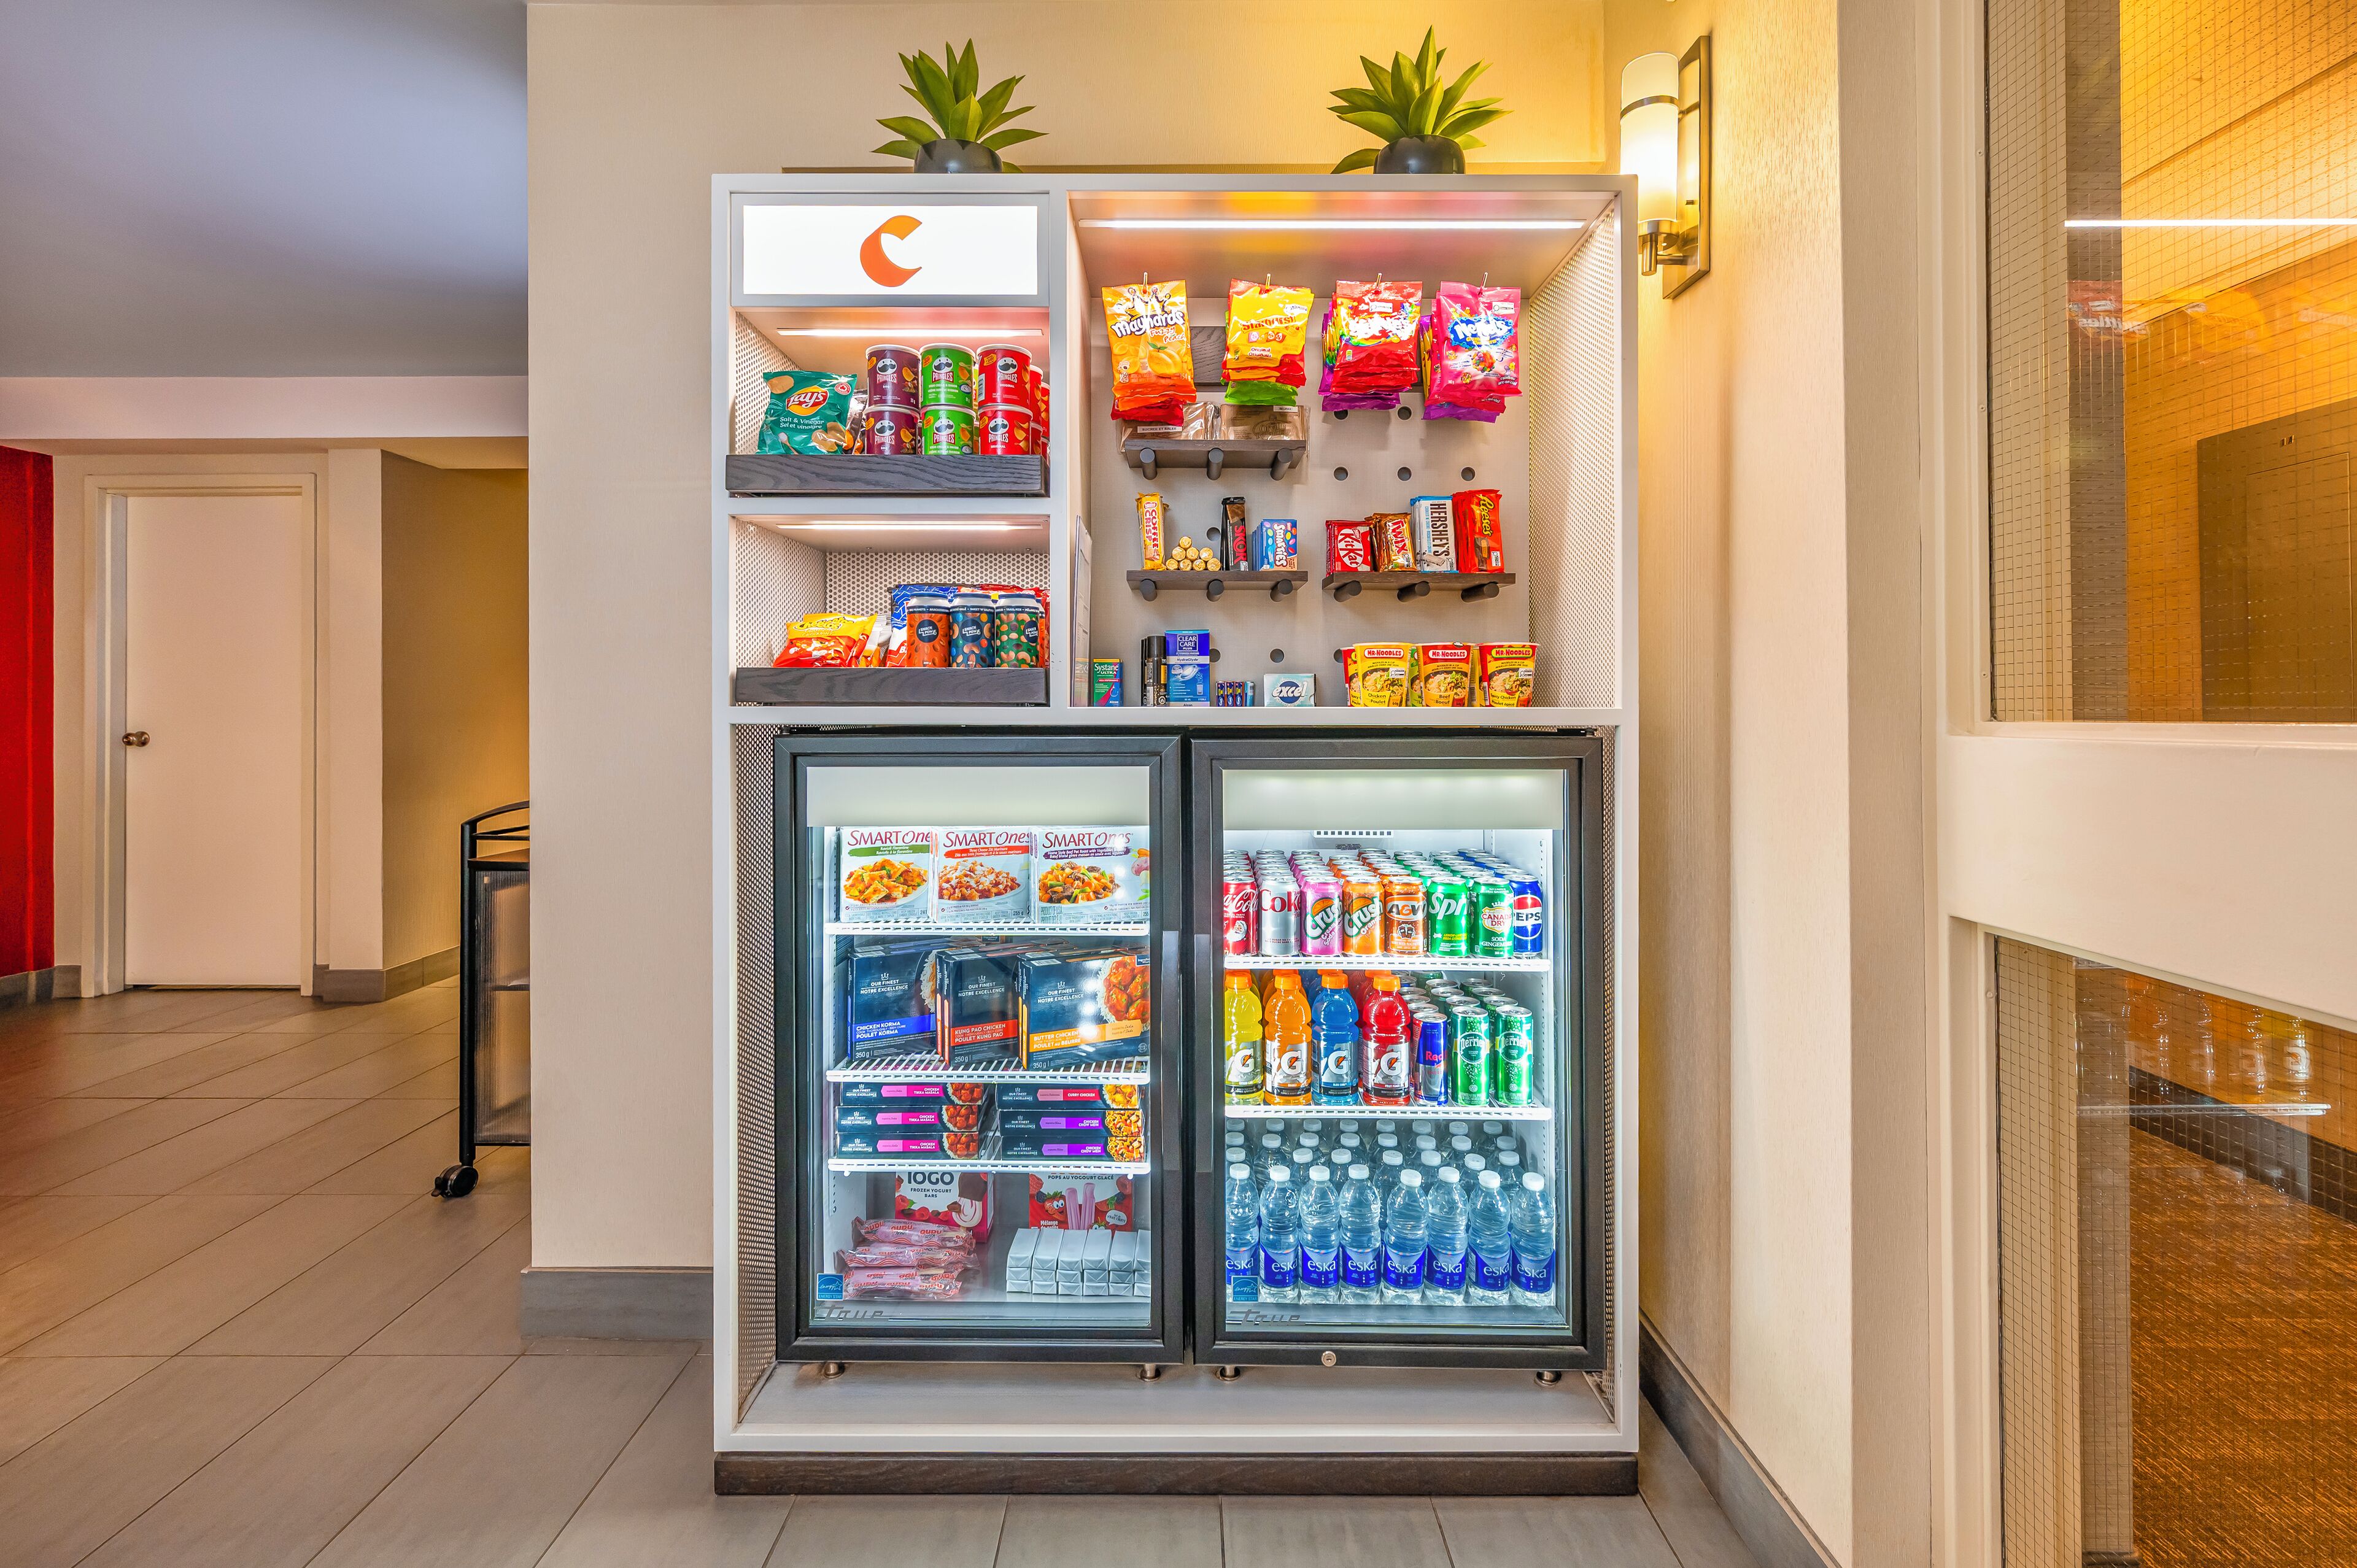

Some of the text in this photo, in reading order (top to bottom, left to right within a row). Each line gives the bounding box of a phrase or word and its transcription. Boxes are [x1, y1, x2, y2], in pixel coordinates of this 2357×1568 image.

[1150, 327, 1175, 337] Fuzzy
[877, 374, 897, 383] PRINGLES
[932, 372, 953, 382] PRINGLES
[997, 373, 1018, 383] PRINGLES
[788, 391, 826, 408] Lay's
[875, 435, 894, 444] PRINGLES
[934, 434, 954, 443] PRINGLES
[989, 434, 1008, 442] PRINGLES
[1430, 503, 1450, 557] HERSHEY'S
[1234, 525, 1247, 563] SKOR
[1094, 663, 1119, 673] Systane
[1272, 682, 1307, 697] excel
[848, 830, 902, 846] SMART
[943, 832, 996, 848] SMART
[1043, 832, 1094, 848] SMART
[1344, 896, 1384, 937] Crush
[1387, 904, 1426, 916] A&W
[1306, 897, 1343, 938] Crush
[878, 984, 908, 993] EXCELLENCE
[975, 986, 1005, 995] EXCELLENCE
[983, 1023, 1006, 1032] CHICKEN
[1234, 1049, 1254, 1073] G
[1280, 1050, 1301, 1075] G
[1328, 1049, 1349, 1075] G
[1380, 1051, 1402, 1076] G
[1226, 1257, 1254, 1270] eska
[1272, 1258, 1298, 1272] eska
[1307, 1260, 1336, 1272] eska
[1348, 1260, 1377, 1272] eska
[1387, 1261, 1417, 1274] eska
[1433, 1261, 1462, 1273] eska
[1483, 1263, 1509, 1277] eska
[1517, 1264, 1546, 1278] eska
